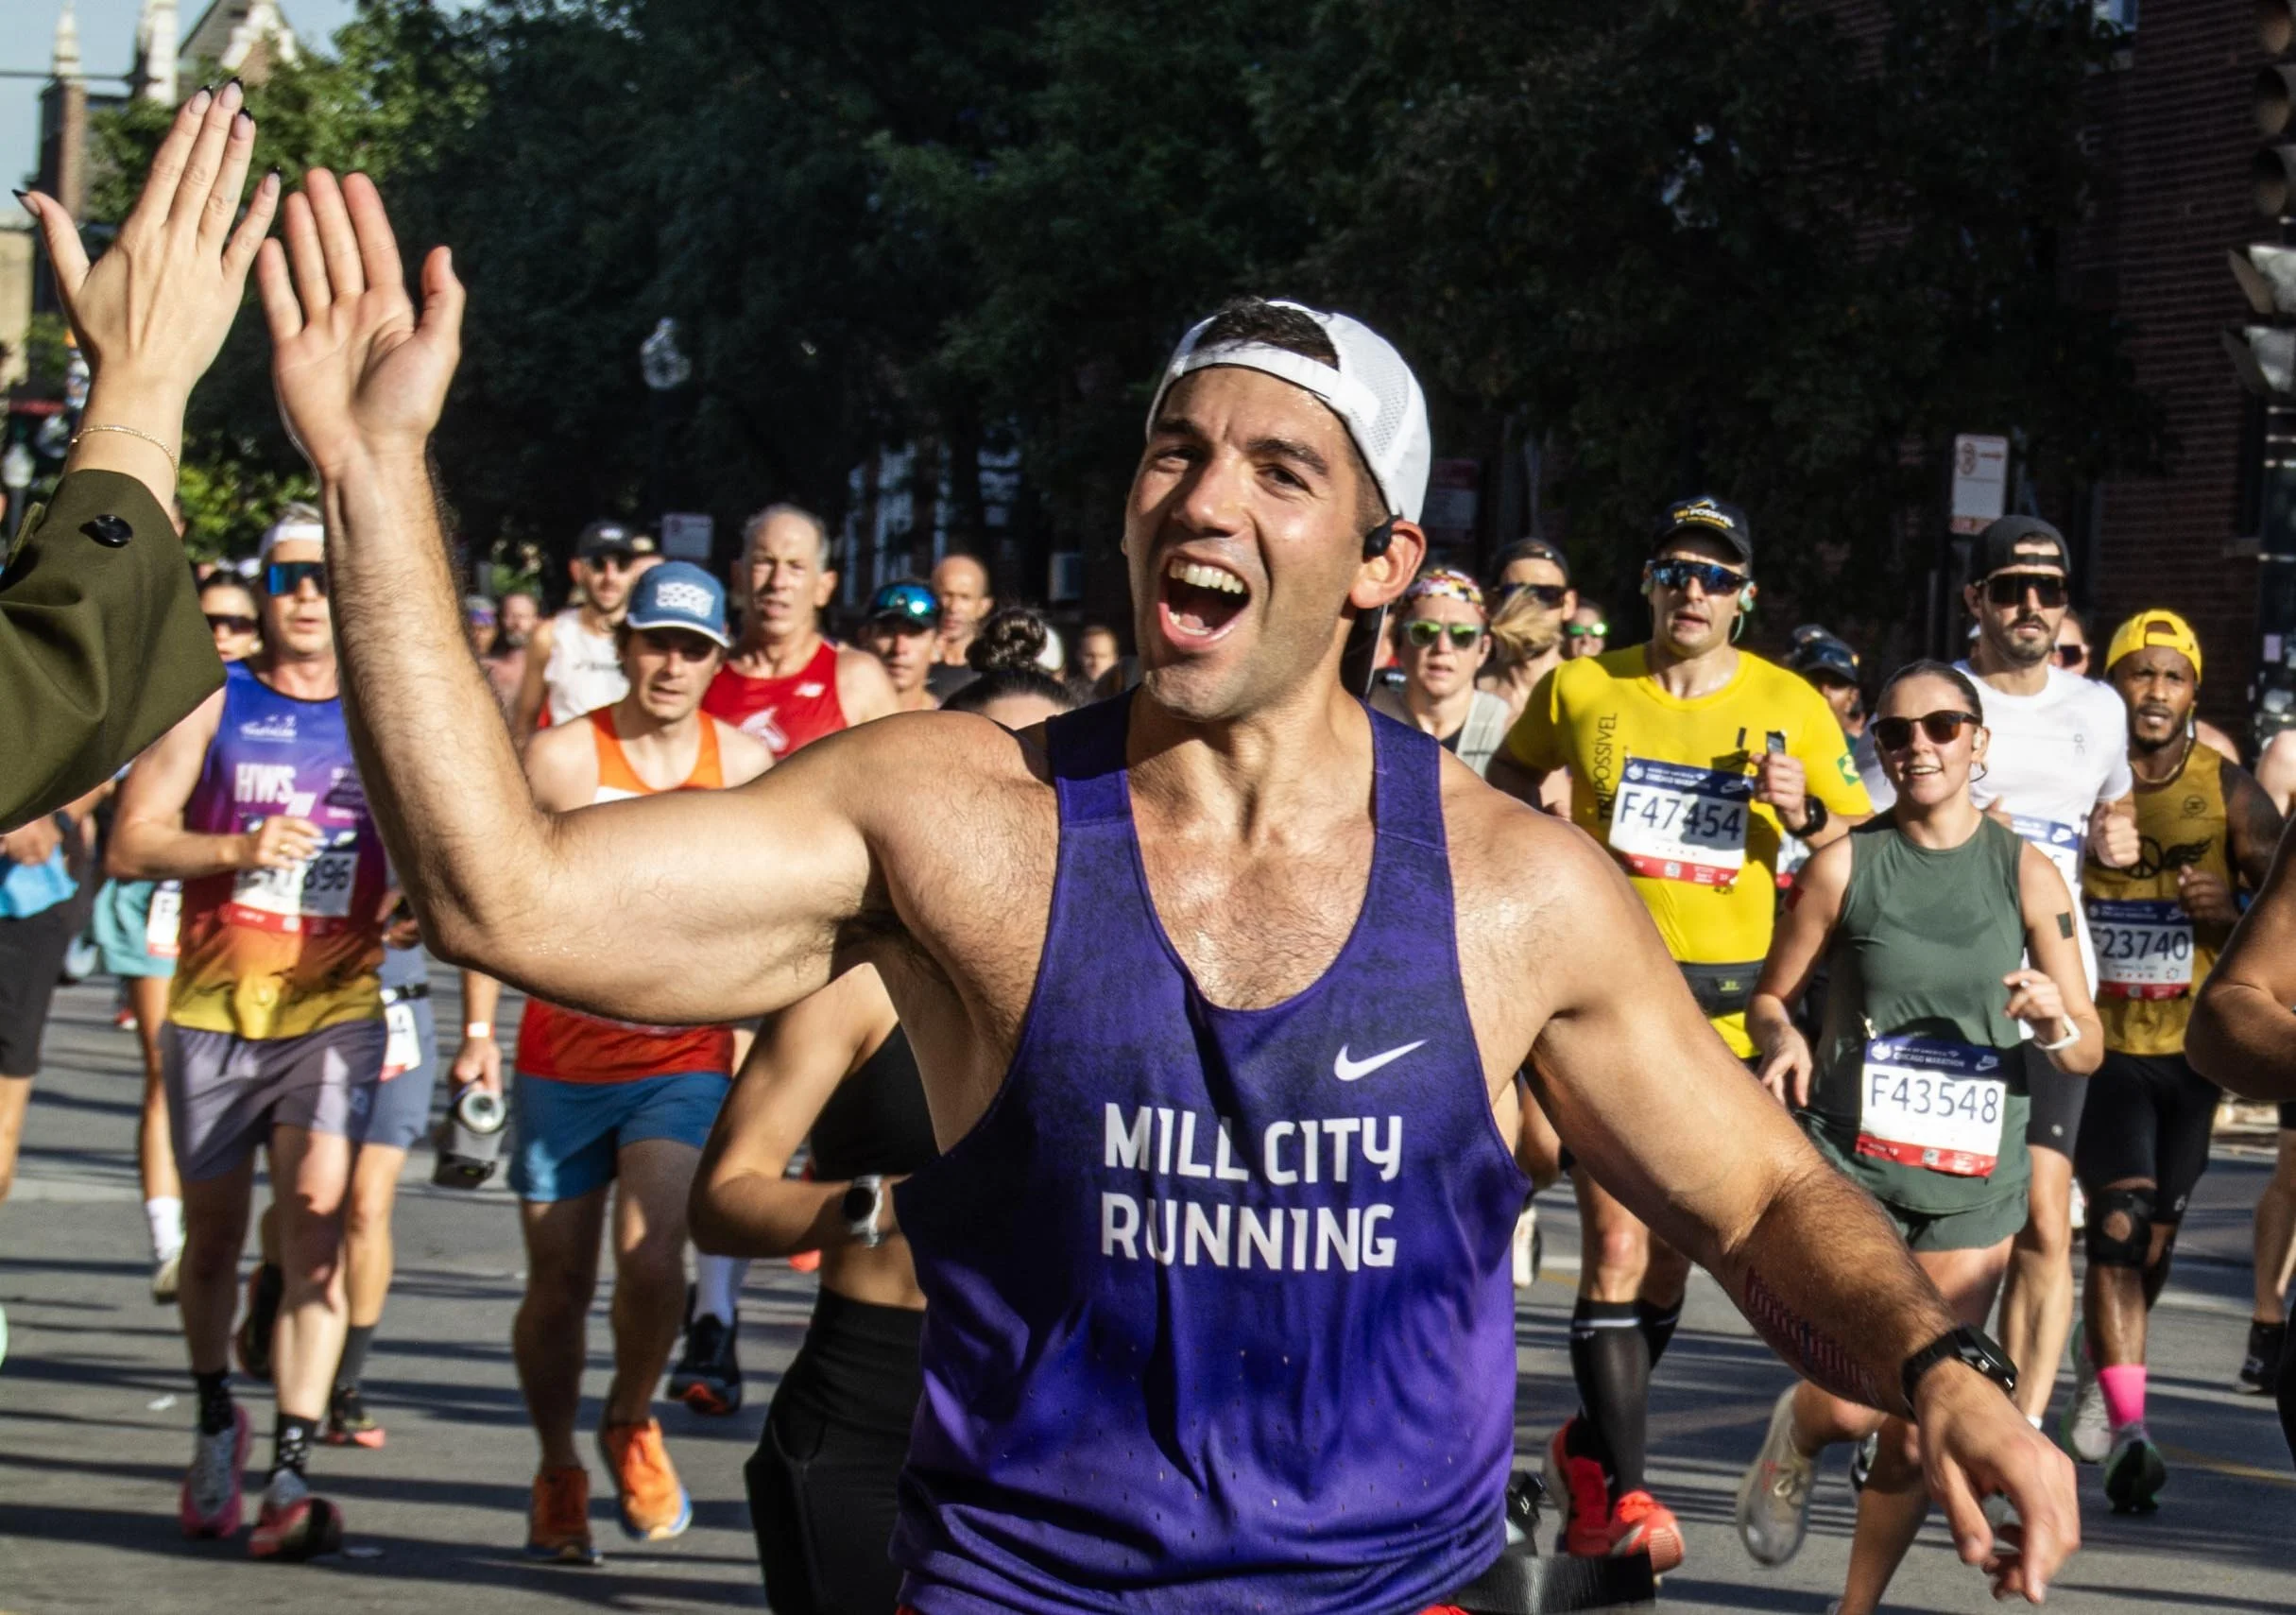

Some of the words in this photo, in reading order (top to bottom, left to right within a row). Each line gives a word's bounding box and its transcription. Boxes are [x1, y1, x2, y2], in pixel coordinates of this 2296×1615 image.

[234, 763, 297, 803] HWS
[1619, 791, 1741, 841] F47454
[1871, 1074, 1998, 1124] F43548
[1105, 1102, 1249, 1181] MILL
[1264, 1116, 1402, 1185] CITY
[1102, 1192, 1396, 1272] RUNNING
